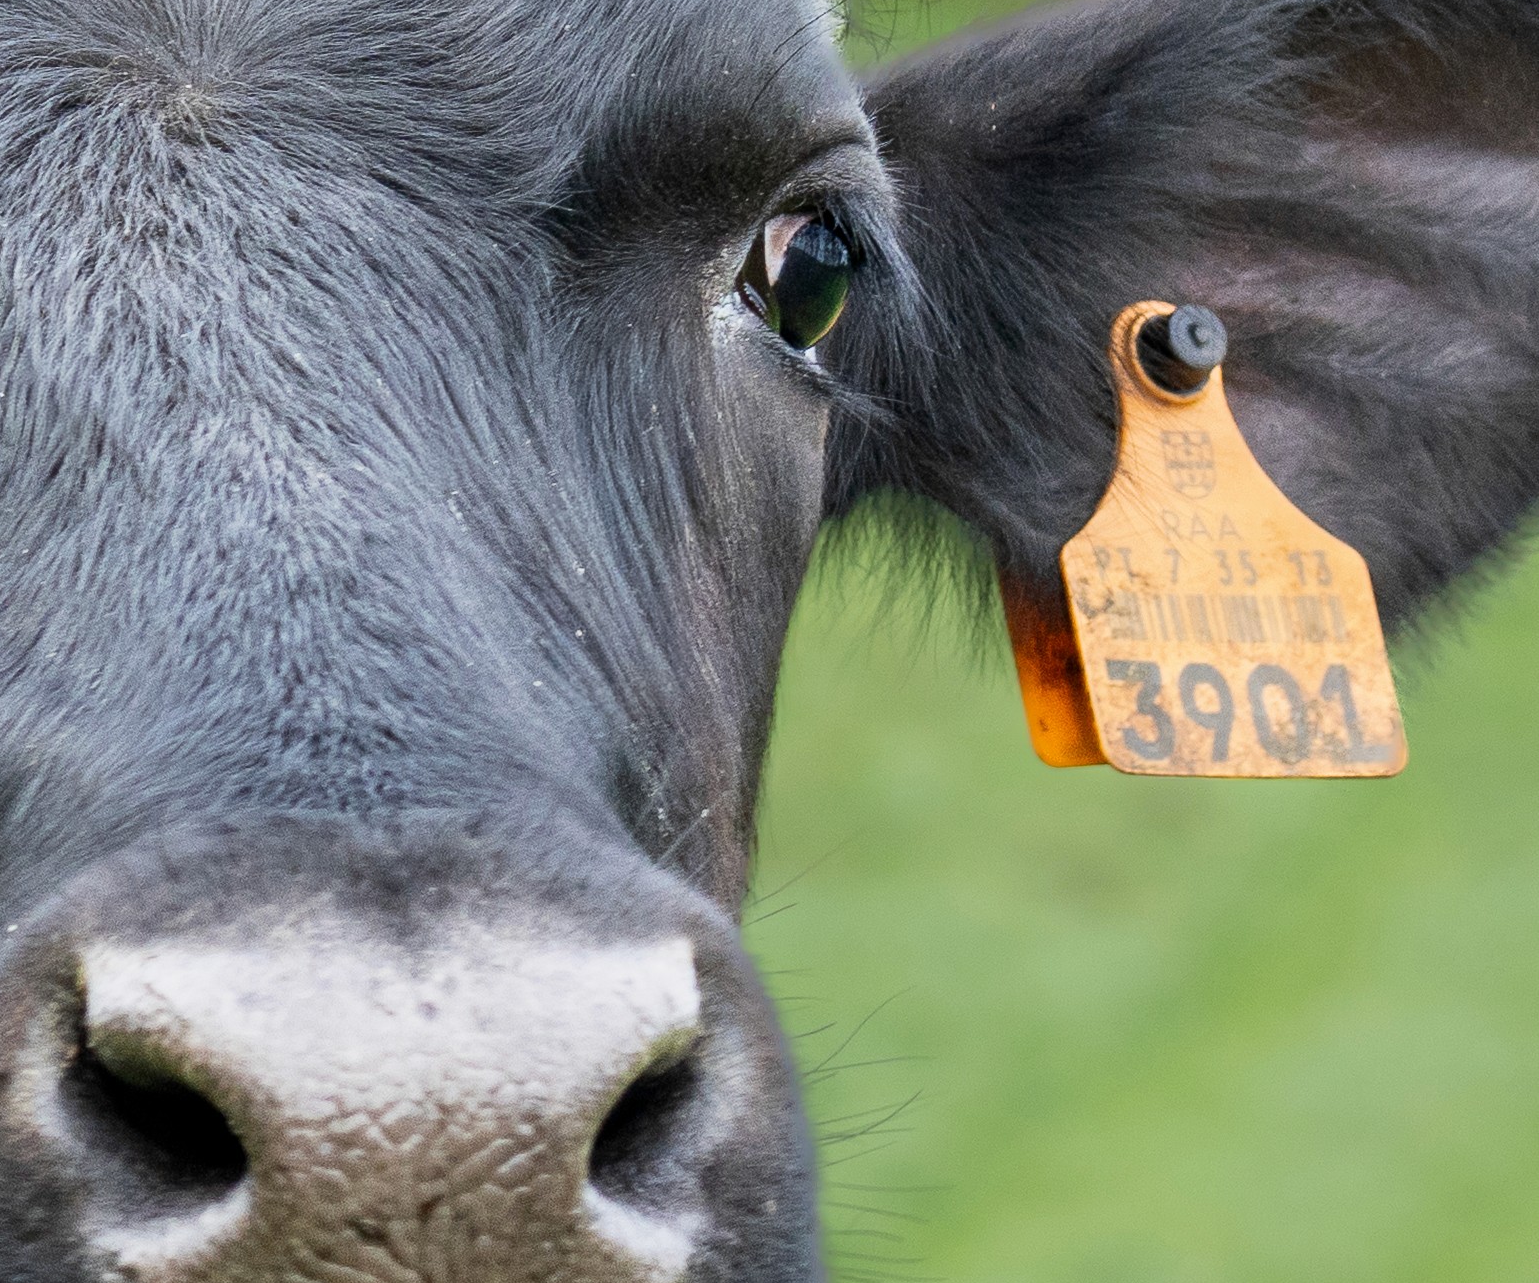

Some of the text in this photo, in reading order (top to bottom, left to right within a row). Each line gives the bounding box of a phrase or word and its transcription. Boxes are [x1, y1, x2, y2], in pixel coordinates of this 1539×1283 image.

[1162, 509, 1243, 542] RAA
[1093, 546, 1136, 585] PT
[1164, 548, 1180, 585] 7
[1214, 549, 1258, 586] 35
[1103, 659, 1393, 764] 3901
